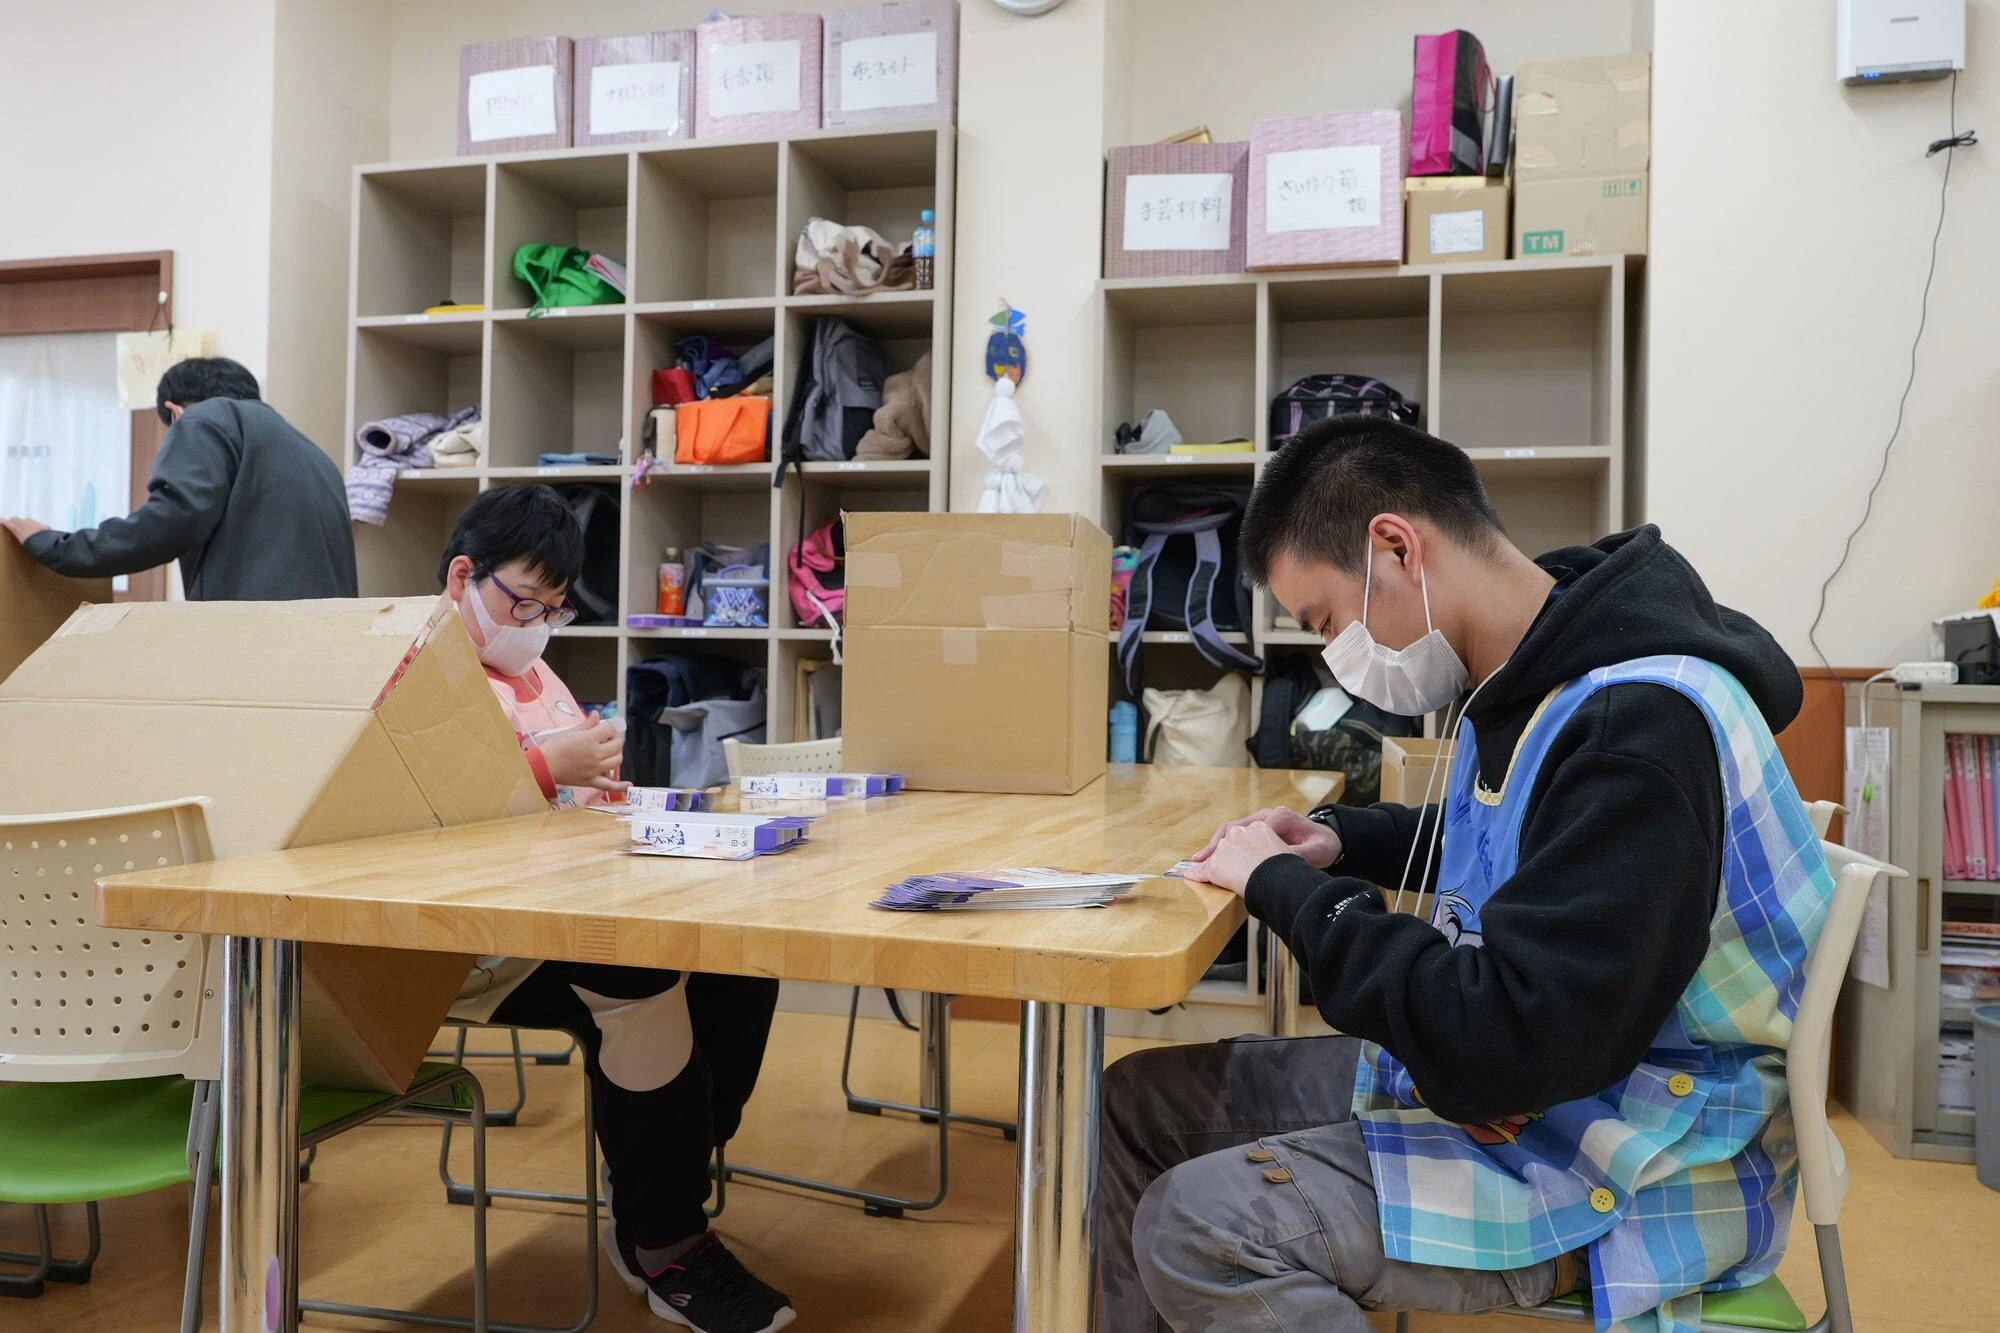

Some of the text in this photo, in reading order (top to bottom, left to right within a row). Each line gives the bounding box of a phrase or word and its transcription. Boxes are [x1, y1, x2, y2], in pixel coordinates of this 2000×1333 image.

[1138, 195, 1225, 224] 手芸材料
[1527, 234, 1560, 251] TM
